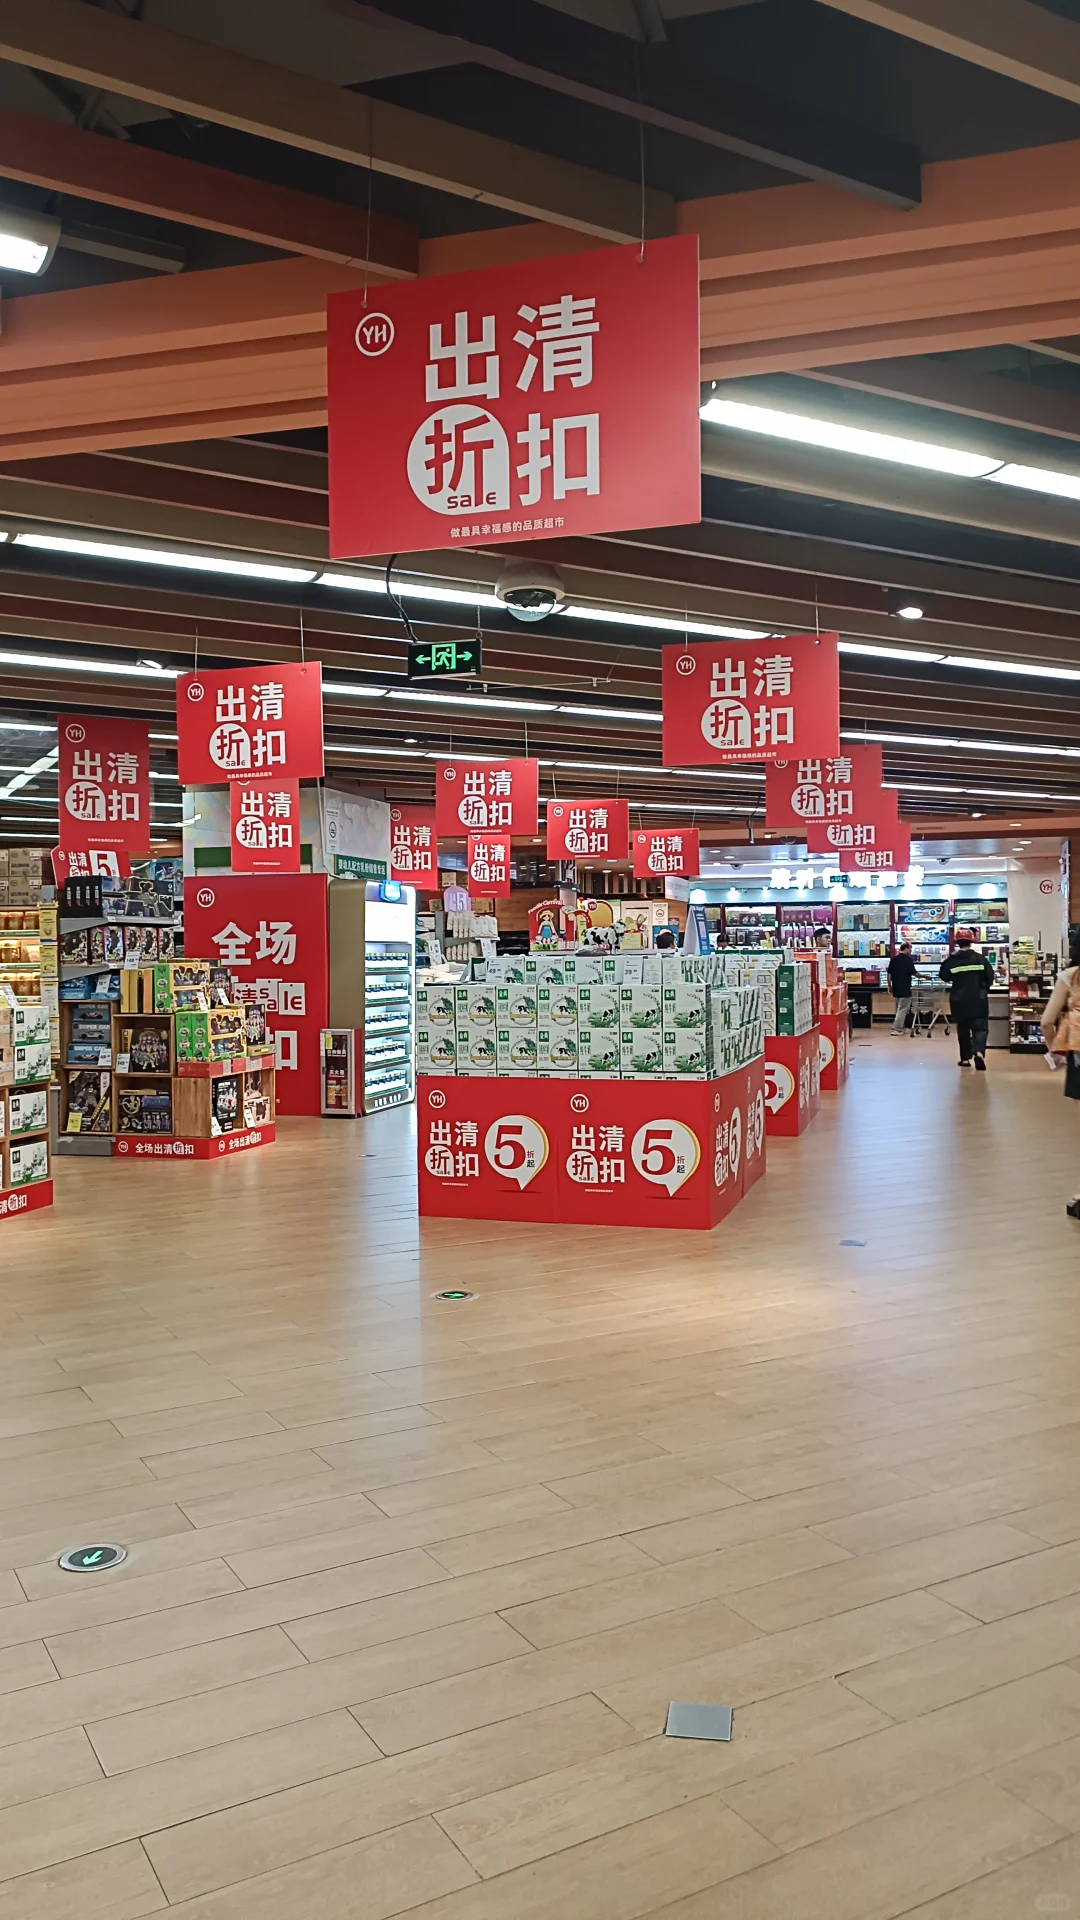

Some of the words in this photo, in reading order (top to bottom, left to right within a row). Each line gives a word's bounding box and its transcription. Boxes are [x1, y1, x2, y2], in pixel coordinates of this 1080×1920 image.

[362, 324, 388, 346] YH
[425, 294, 600, 402] 出清
[420, 412, 600, 508] 折扣
[446, 491, 497, 510] sale
[450, 517, 565, 539] 做最具幸福感的品质超市
[680, 660, 693, 670] YH
[709, 654, 794, 698] 出清
[190, 687, 202, 698] YH
[215, 681, 285, 723] 出清
[69, 728, 83, 739] YH
[708, 704, 795, 748] 折扣
[215, 728, 286, 768] 折扣
[72, 749, 139, 785] 出清
[797, 756, 853, 784] 出清
[463, 769, 513, 797] 出清
[71, 785, 140, 822] 折扣
[240, 790, 292, 818] 出清
[462, 799, 513, 827] 折扣
[796, 787, 853, 816] 折扣
[568, 807, 609, 829] 出清
[240, 819, 293, 849] 折扣
[393, 824, 432, 847] 出清
[568, 830, 609, 853] 折扣
[650, 835, 683, 853] 出清
[830, 823, 875, 846] 折扣
[68, 851, 88, 868] 出清
[393, 847, 432, 871] 折扣
[473, 842, 506, 862] 出清
[650, 854, 684, 872] 折扣
[857, 850, 893, 868] 折扣
[473, 861, 506, 883] 折扣
[199, 892, 212, 903] YH
[211, 920, 297, 966] 全场
[764, 1068, 778, 1101] 5
[431, 1095, 443, 1104] YH
[573, 1099, 586, 1108] YH
[228, 1131, 263, 1150] 全场出清折扣
[429, 1119, 479, 1147] 出清
[571, 1124, 625, 1152] 出清
[715, 1120, 729, 1152] 出清
[730, 1116, 738, 1165] 5
[135, 1140, 195, 1155] 全场出清折扣
[493, 1124, 527, 1170] 5
[526, 1150, 536, 1169] 折起
[641, 1129, 676, 1176] 5
[428, 1148, 480, 1177] 折扣
[570, 1153, 626, 1184] 折扣
[676, 1155, 686, 1174] 折起
